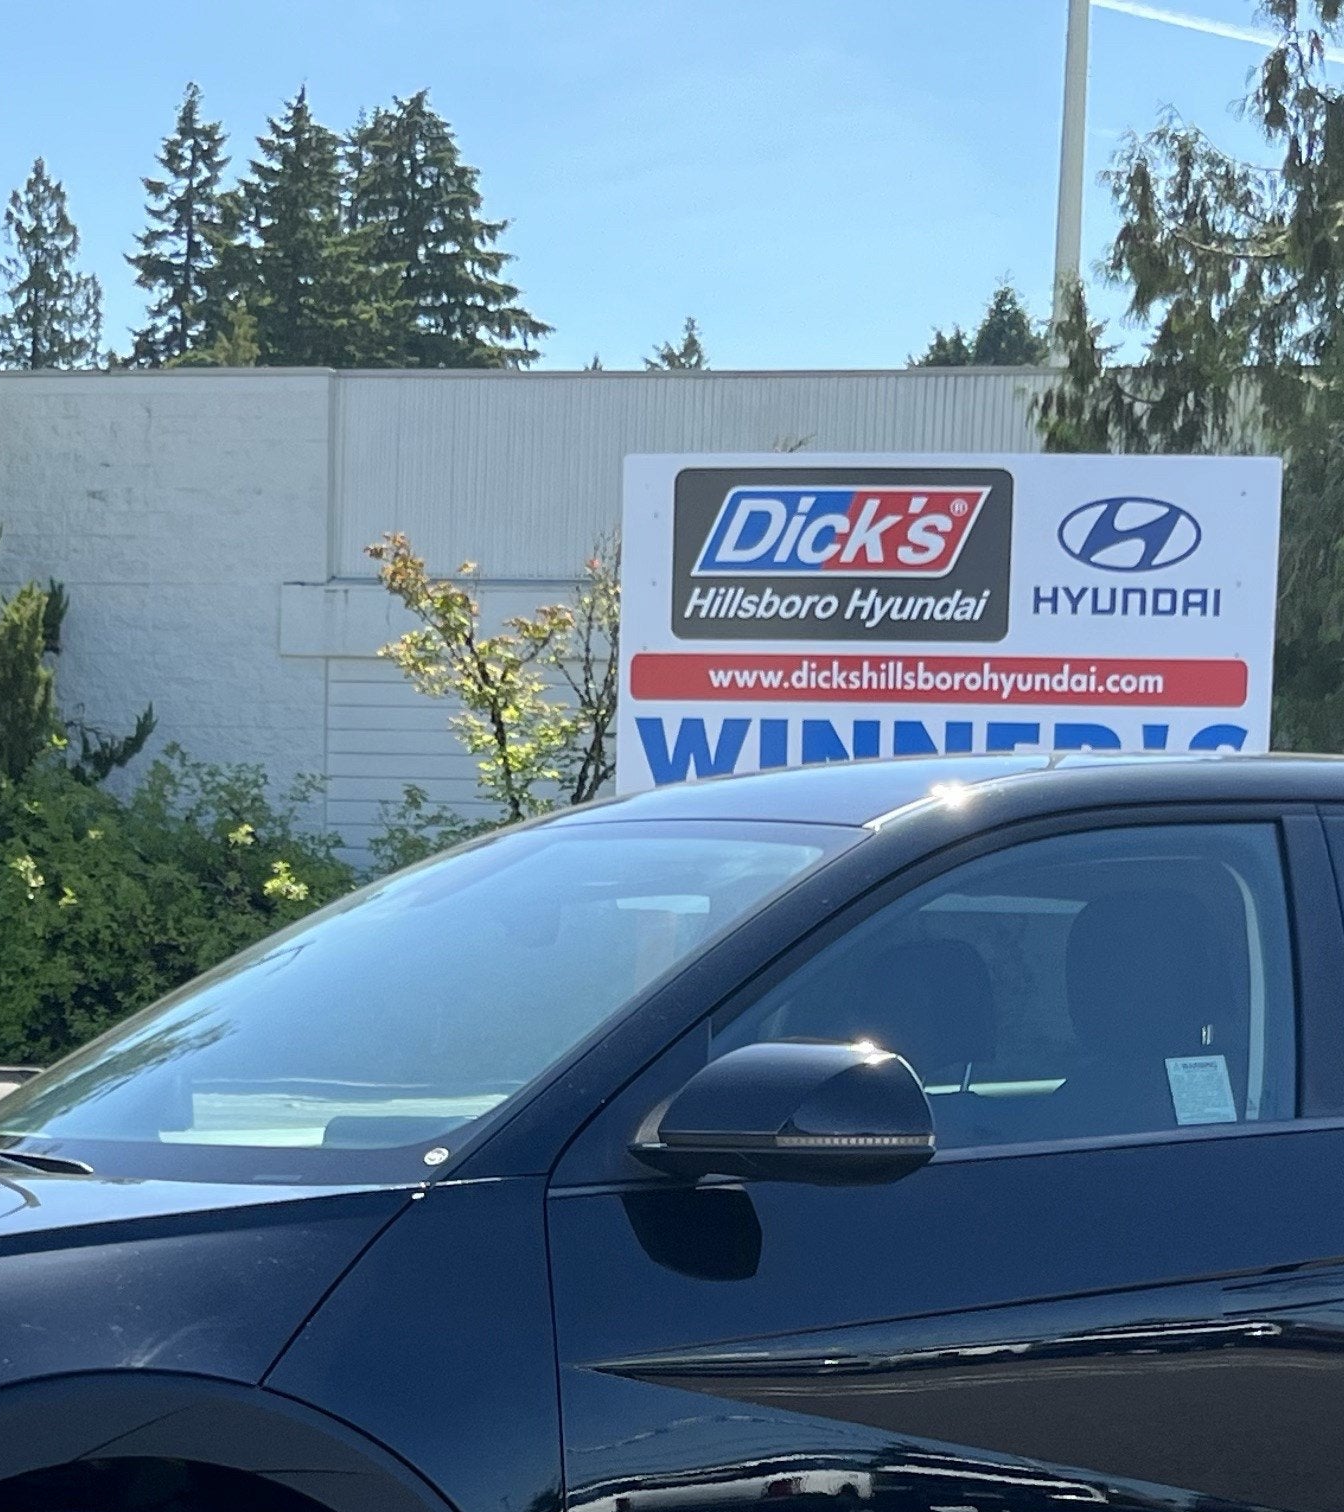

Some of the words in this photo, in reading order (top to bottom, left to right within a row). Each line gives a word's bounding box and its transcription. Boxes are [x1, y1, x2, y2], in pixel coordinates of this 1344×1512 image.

[715, 496, 953, 564] Dick's
[684, 587, 839, 621] Hillsboro
[844, 588, 991, 628] Hyundai
[1033, 586, 1221, 617] HYUNDAI
[709, 660, 1164, 699] www.dickshillsborohyundai.com
